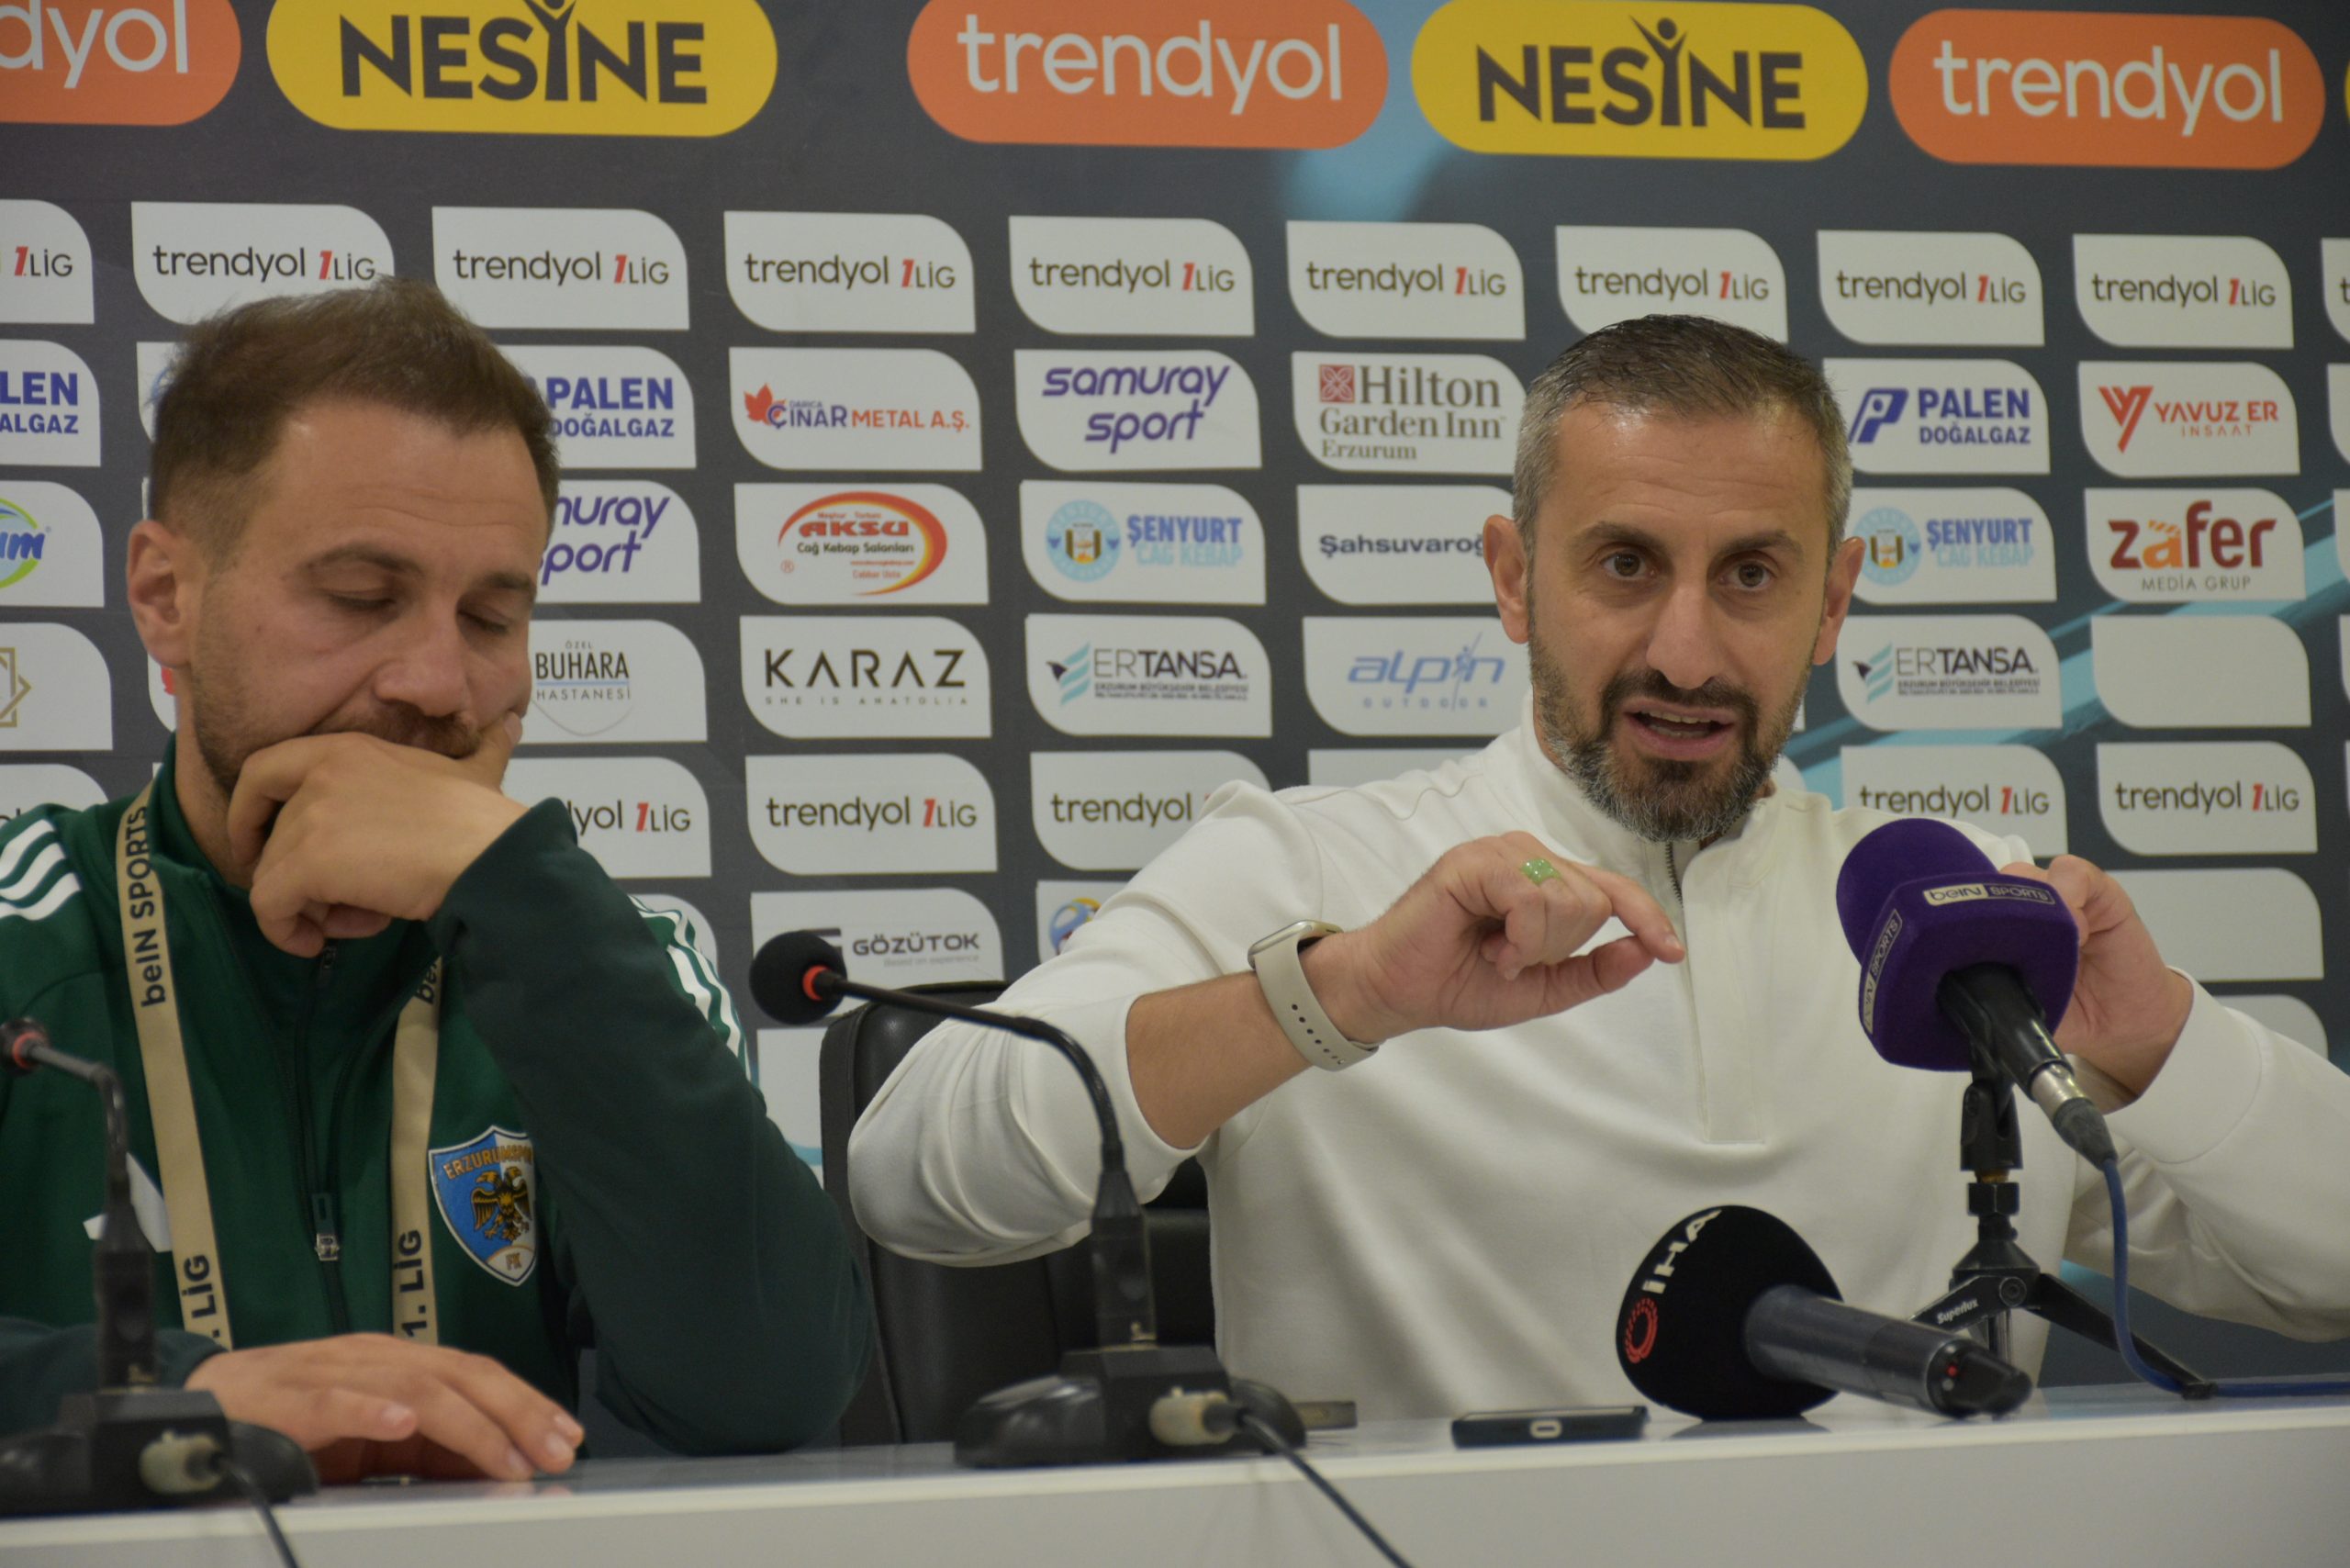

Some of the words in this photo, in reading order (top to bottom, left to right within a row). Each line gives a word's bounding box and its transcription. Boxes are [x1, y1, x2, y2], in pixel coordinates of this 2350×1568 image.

[957, 14, 1342, 116] trendyol
[1932, 39, 2283, 138] trendyol
[151, 244, 306, 284] trendyol
[453, 249, 602, 287] trendyol
[744, 252, 890, 291] trendyol
[1028, 257, 1171, 295] trendyol
[1305, 261, 1444, 298] trendyol
[1573, 265, 1708, 302] trendyol
[1835, 270, 1967, 306] trendyol
[2090, 273, 2219, 309] trendyol
[0, 370, 79, 407] LEN
[546, 377, 674, 410] PALEN
[1042, 364, 1231, 409] samuray
[1360, 365, 1501, 409] Hilton
[1918, 387, 2031, 420] PALEN
[0, 412, 79, 434] ALGAZ
[553, 412, 675, 437] DOĞALGAZ
[851, 409, 925, 429] METAL
[930, 409, 970, 432] A.Ş.
[1084, 398, 1204, 454] sport
[1319, 407, 1438, 438] Garden
[2154, 400, 2240, 423] YAVUZ
[2246, 400, 2278, 422] ER
[1321, 438, 1417, 460] Erzurum
[1919, 421, 2031, 445] DOĞALGAZ
[822, 542, 860, 555] Kebap
[862, 541, 915, 554] Salonları
[1126, 514, 1243, 550] ŞENYURT
[1317, 531, 1487, 560] Şahsuvaroğ
[1925, 517, 2033, 551] ŞENYURT
[2108, 500, 2277, 570] zafer
[540, 529, 643, 588] port
[2204, 575, 2251, 591] GRUP
[534, 651, 632, 680] BUHARA
[765, 648, 967, 689] KARAZ
[535, 688, 633, 701] HASTANESİ
[766, 795, 912, 833] trendyol
[1050, 791, 1193, 828] trendyol
[1859, 783, 1990, 818] trendyol
[2114, 780, 2243, 815] trendyol
[126, 805, 154, 918] SPORTS
[1988, 885, 2050, 902] SPORTS
[852, 932, 980, 957] GÖZÜTOK
[1937, 1298, 1979, 1325] Superlux
